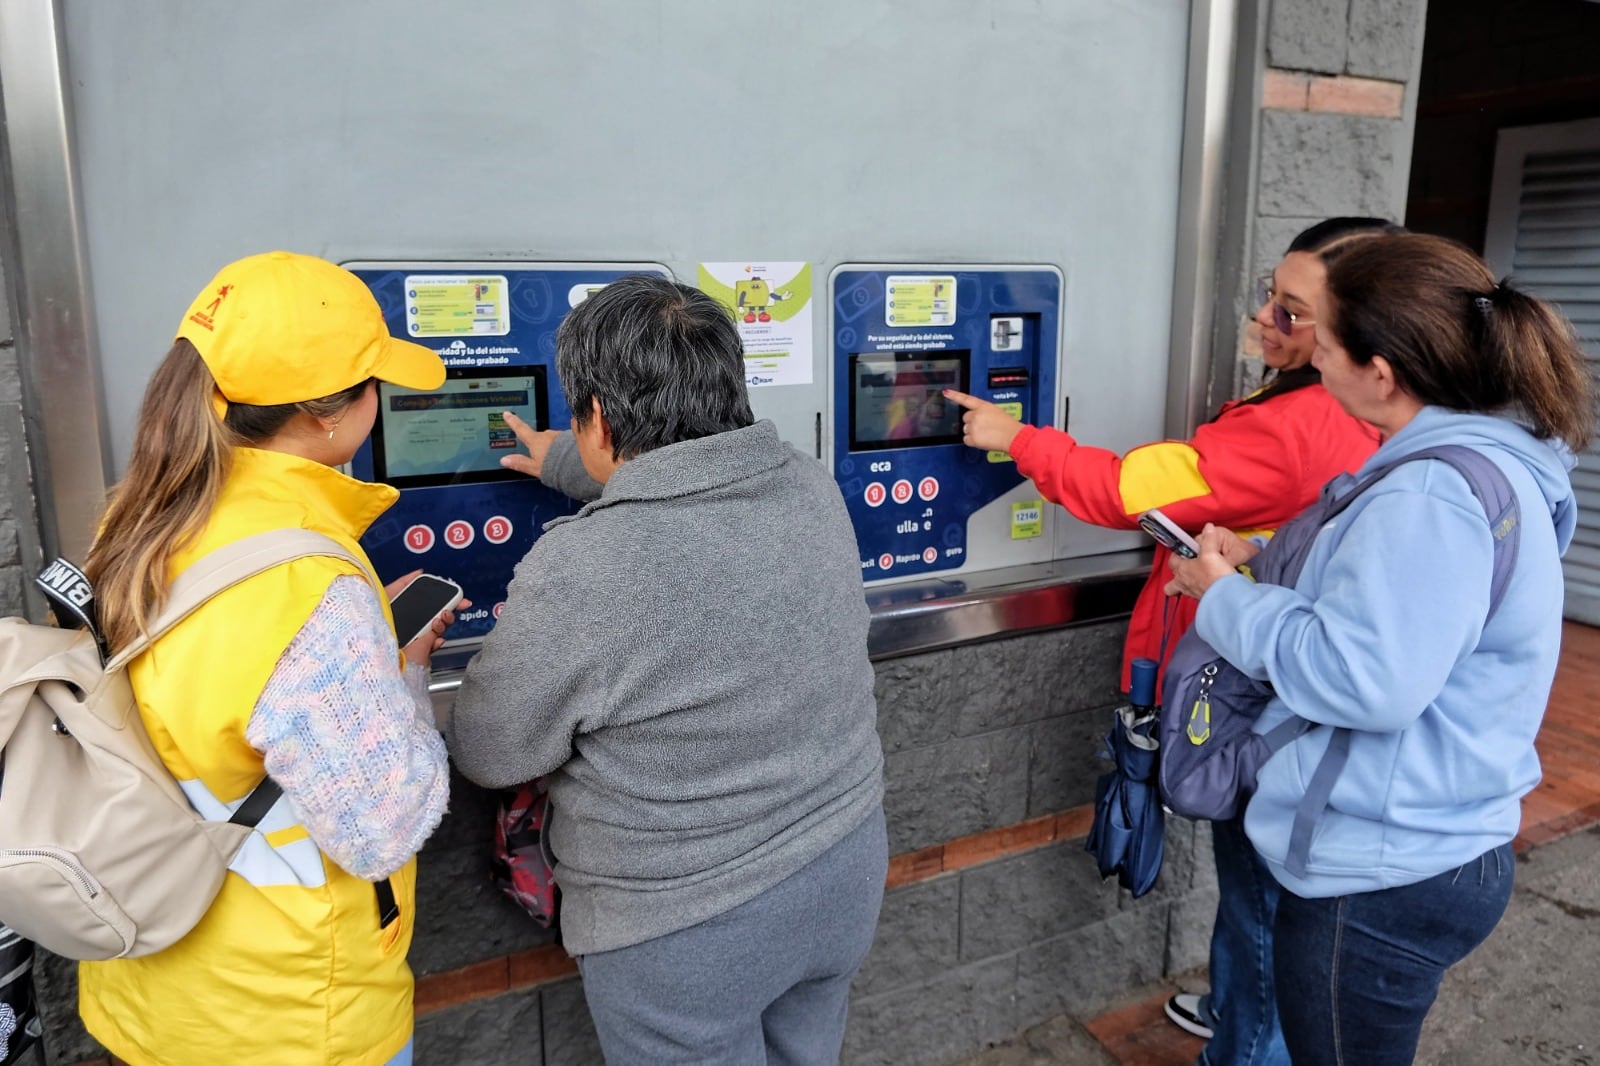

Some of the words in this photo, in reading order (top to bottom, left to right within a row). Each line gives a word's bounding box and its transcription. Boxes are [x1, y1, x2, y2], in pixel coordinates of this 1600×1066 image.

[886, 334, 913, 342] seguridad
[923, 341, 946, 350] grabado
[460, 348, 466, 357] y
[467, 347, 474, 355] la
[475, 346, 488, 355] del
[489, 346, 520, 355] sistema,
[449, 356, 476, 365] siendo
[476, 355, 510, 367] grabado
[870, 461, 892, 473] eca
[1015, 511, 1039, 521] 12146
[896, 520, 919, 534] ulla
[924, 520, 932, 531] e
[413, 531, 424, 546] 1
[453, 527, 465, 542] 2
[491, 523, 504, 537] 3
